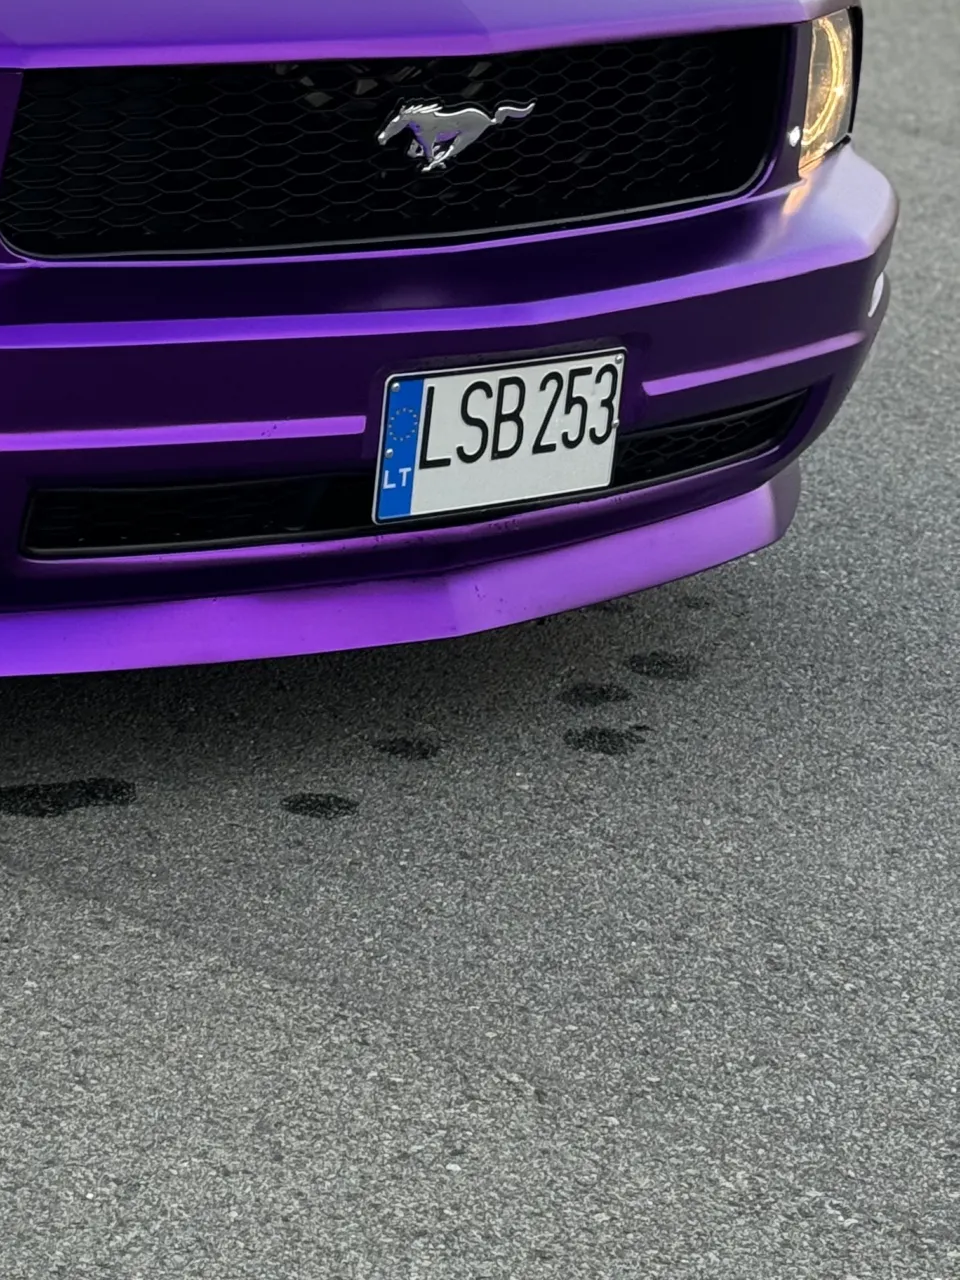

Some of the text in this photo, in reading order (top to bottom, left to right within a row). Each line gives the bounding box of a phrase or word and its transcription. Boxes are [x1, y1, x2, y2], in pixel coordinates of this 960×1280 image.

[419, 363, 619, 470] LSB 253
[382, 467, 413, 490] LT
